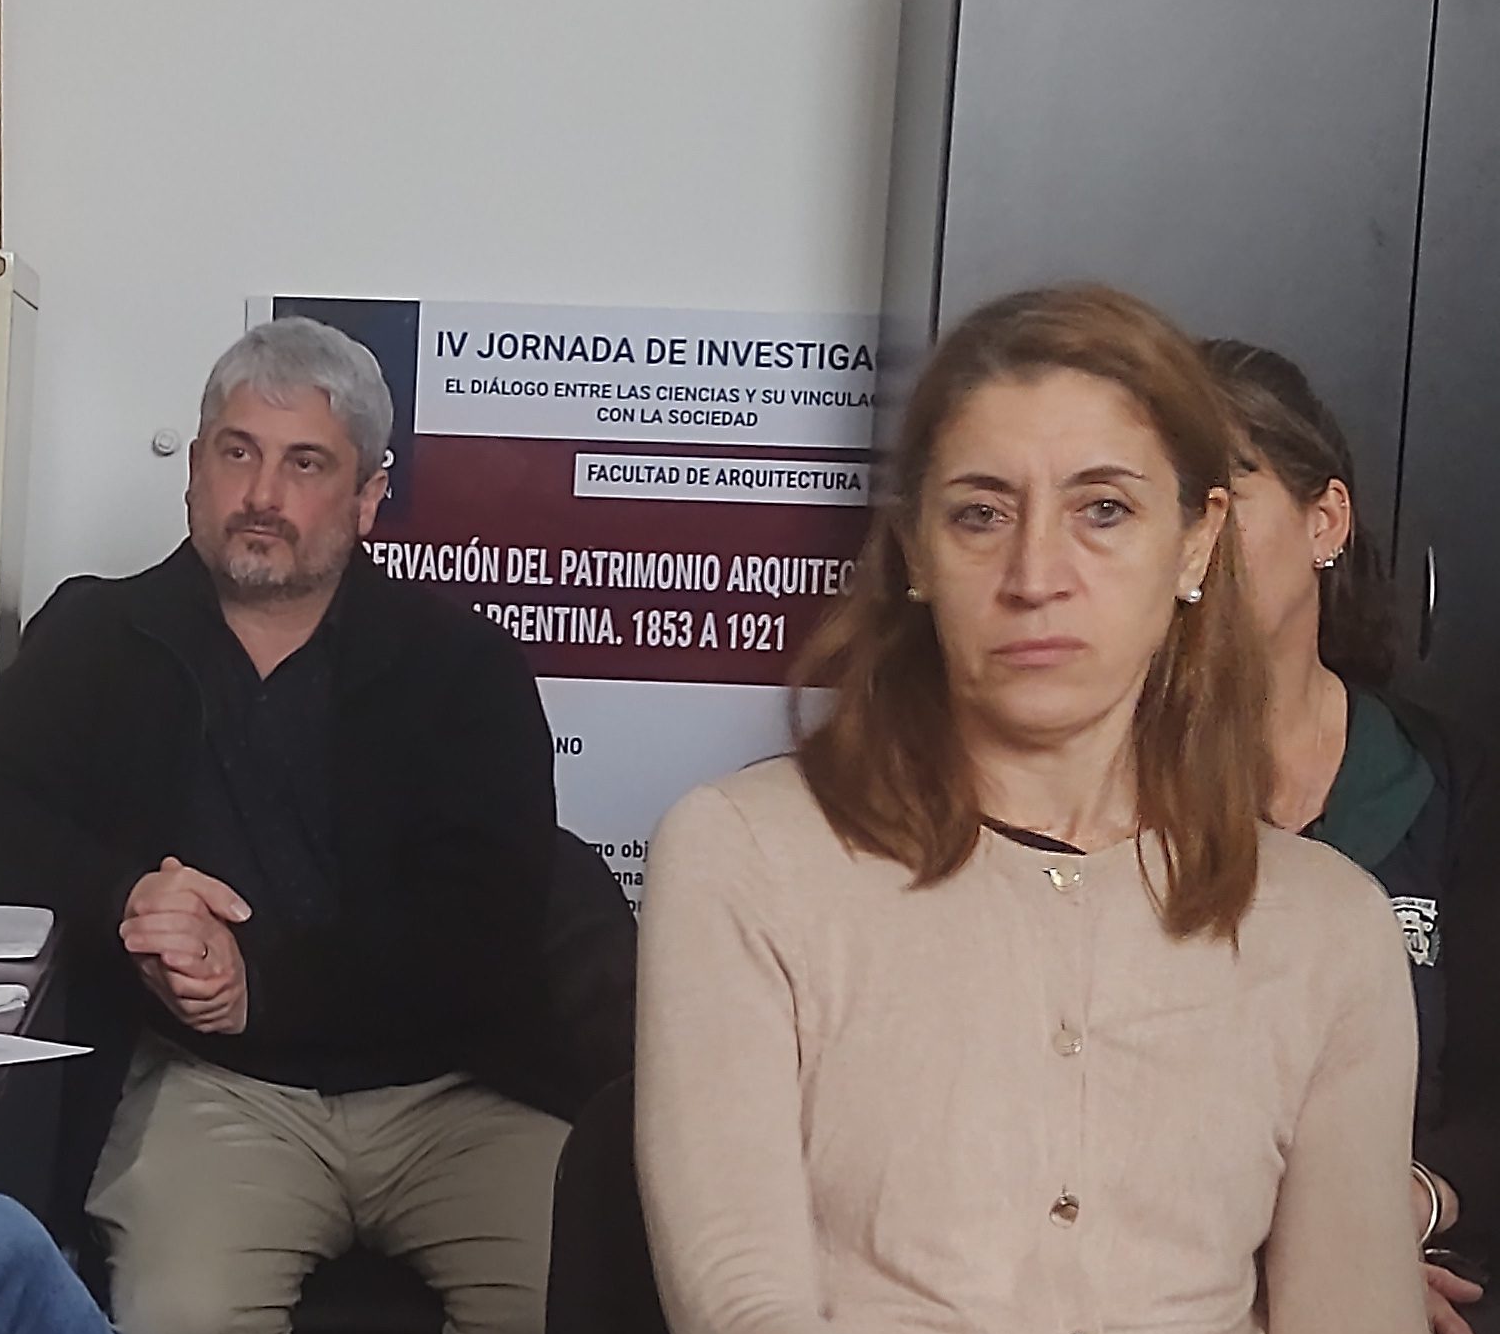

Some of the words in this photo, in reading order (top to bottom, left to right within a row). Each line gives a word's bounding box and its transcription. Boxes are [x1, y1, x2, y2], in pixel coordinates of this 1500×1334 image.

[437, 331, 468, 357] IV
[477, 333, 635, 363] JORNADA
[646, 338, 687, 365] DE
[446, 378, 465, 394] EL
[471, 377, 548, 396] DIÁLOGO
[554, 382, 612, 399] ENTRE
[617, 384, 651, 400] LAS
[656, 386, 740, 403] CIENCIAS
[746, 389, 756, 403] Y
[762, 389, 785, 404] SU
[597, 407, 635, 422] CON
[640, 408, 663, 423] LA
[668, 409, 758, 427] SOCIEDAD
[588, 464, 680, 484] FACULTAD
[687, 467, 710, 485] DE
[715, 468, 861, 491] ARQUITECTURA
[507, 548, 553, 585] DEL
[561, 550, 720, 591] PATRIMONIO
[633, 610, 692, 647] 1853
[699, 612, 718, 648] A
[727, 613, 784, 651] 1921
